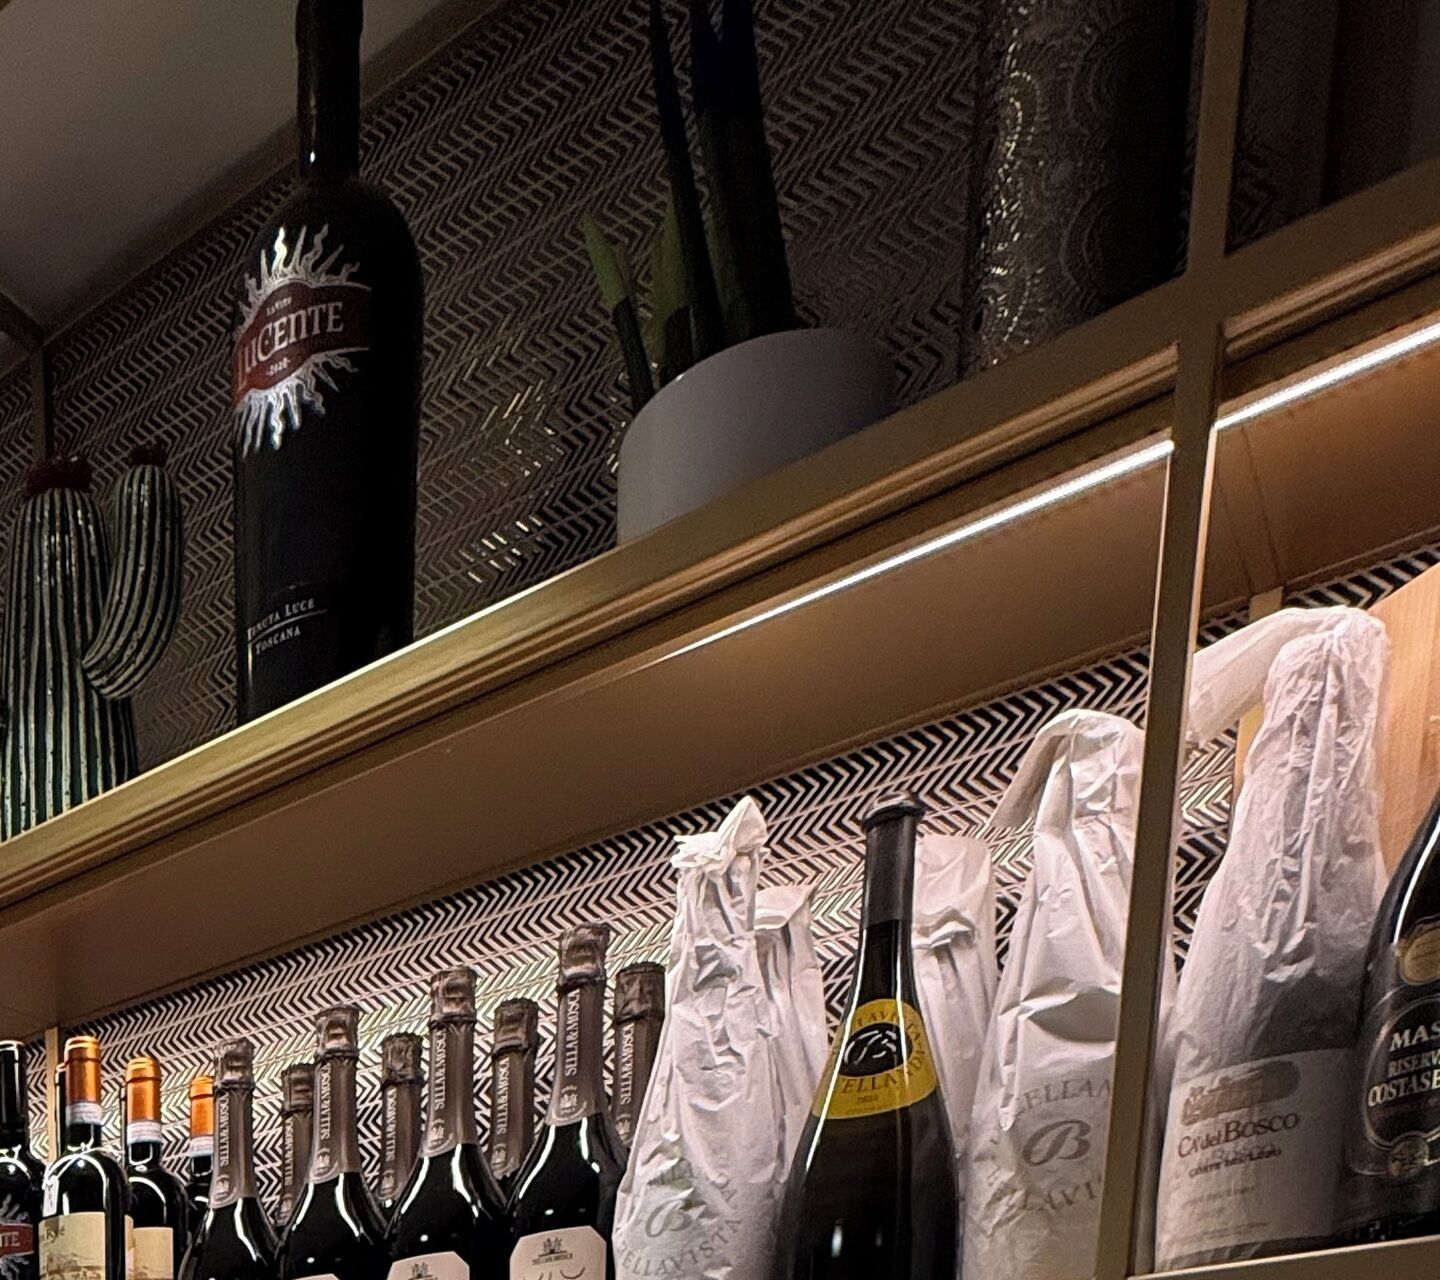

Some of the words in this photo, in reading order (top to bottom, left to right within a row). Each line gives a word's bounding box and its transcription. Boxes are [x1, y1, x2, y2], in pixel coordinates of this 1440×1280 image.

[239, 301, 344, 391] LUCENTE
[285, 598, 315, 617] LUCE
[564, 988, 580, 1077] SELLA&MOSCA
